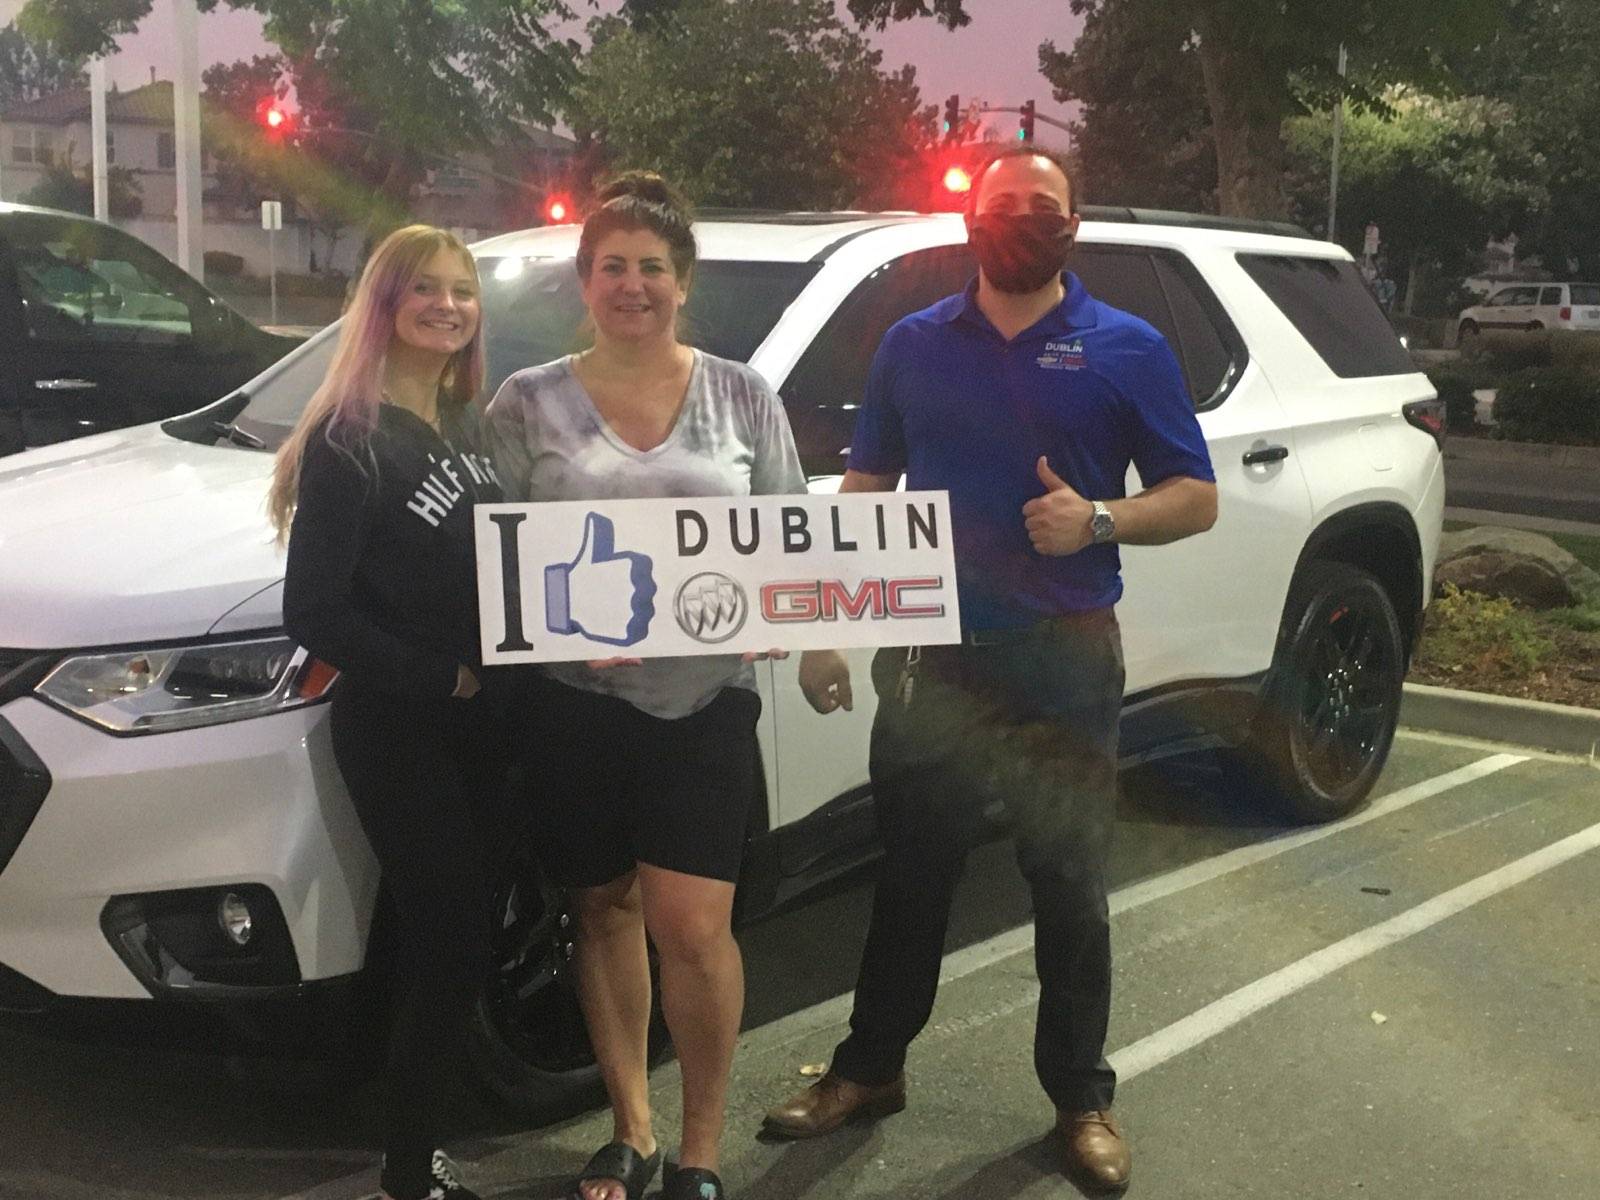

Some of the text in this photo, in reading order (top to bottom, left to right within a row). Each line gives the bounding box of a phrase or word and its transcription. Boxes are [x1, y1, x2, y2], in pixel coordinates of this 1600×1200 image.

[1045, 342, 1083, 353] DUBLIN
[489, 503, 939, 652] I DUBLIN
[760, 575, 946, 624] GMC
